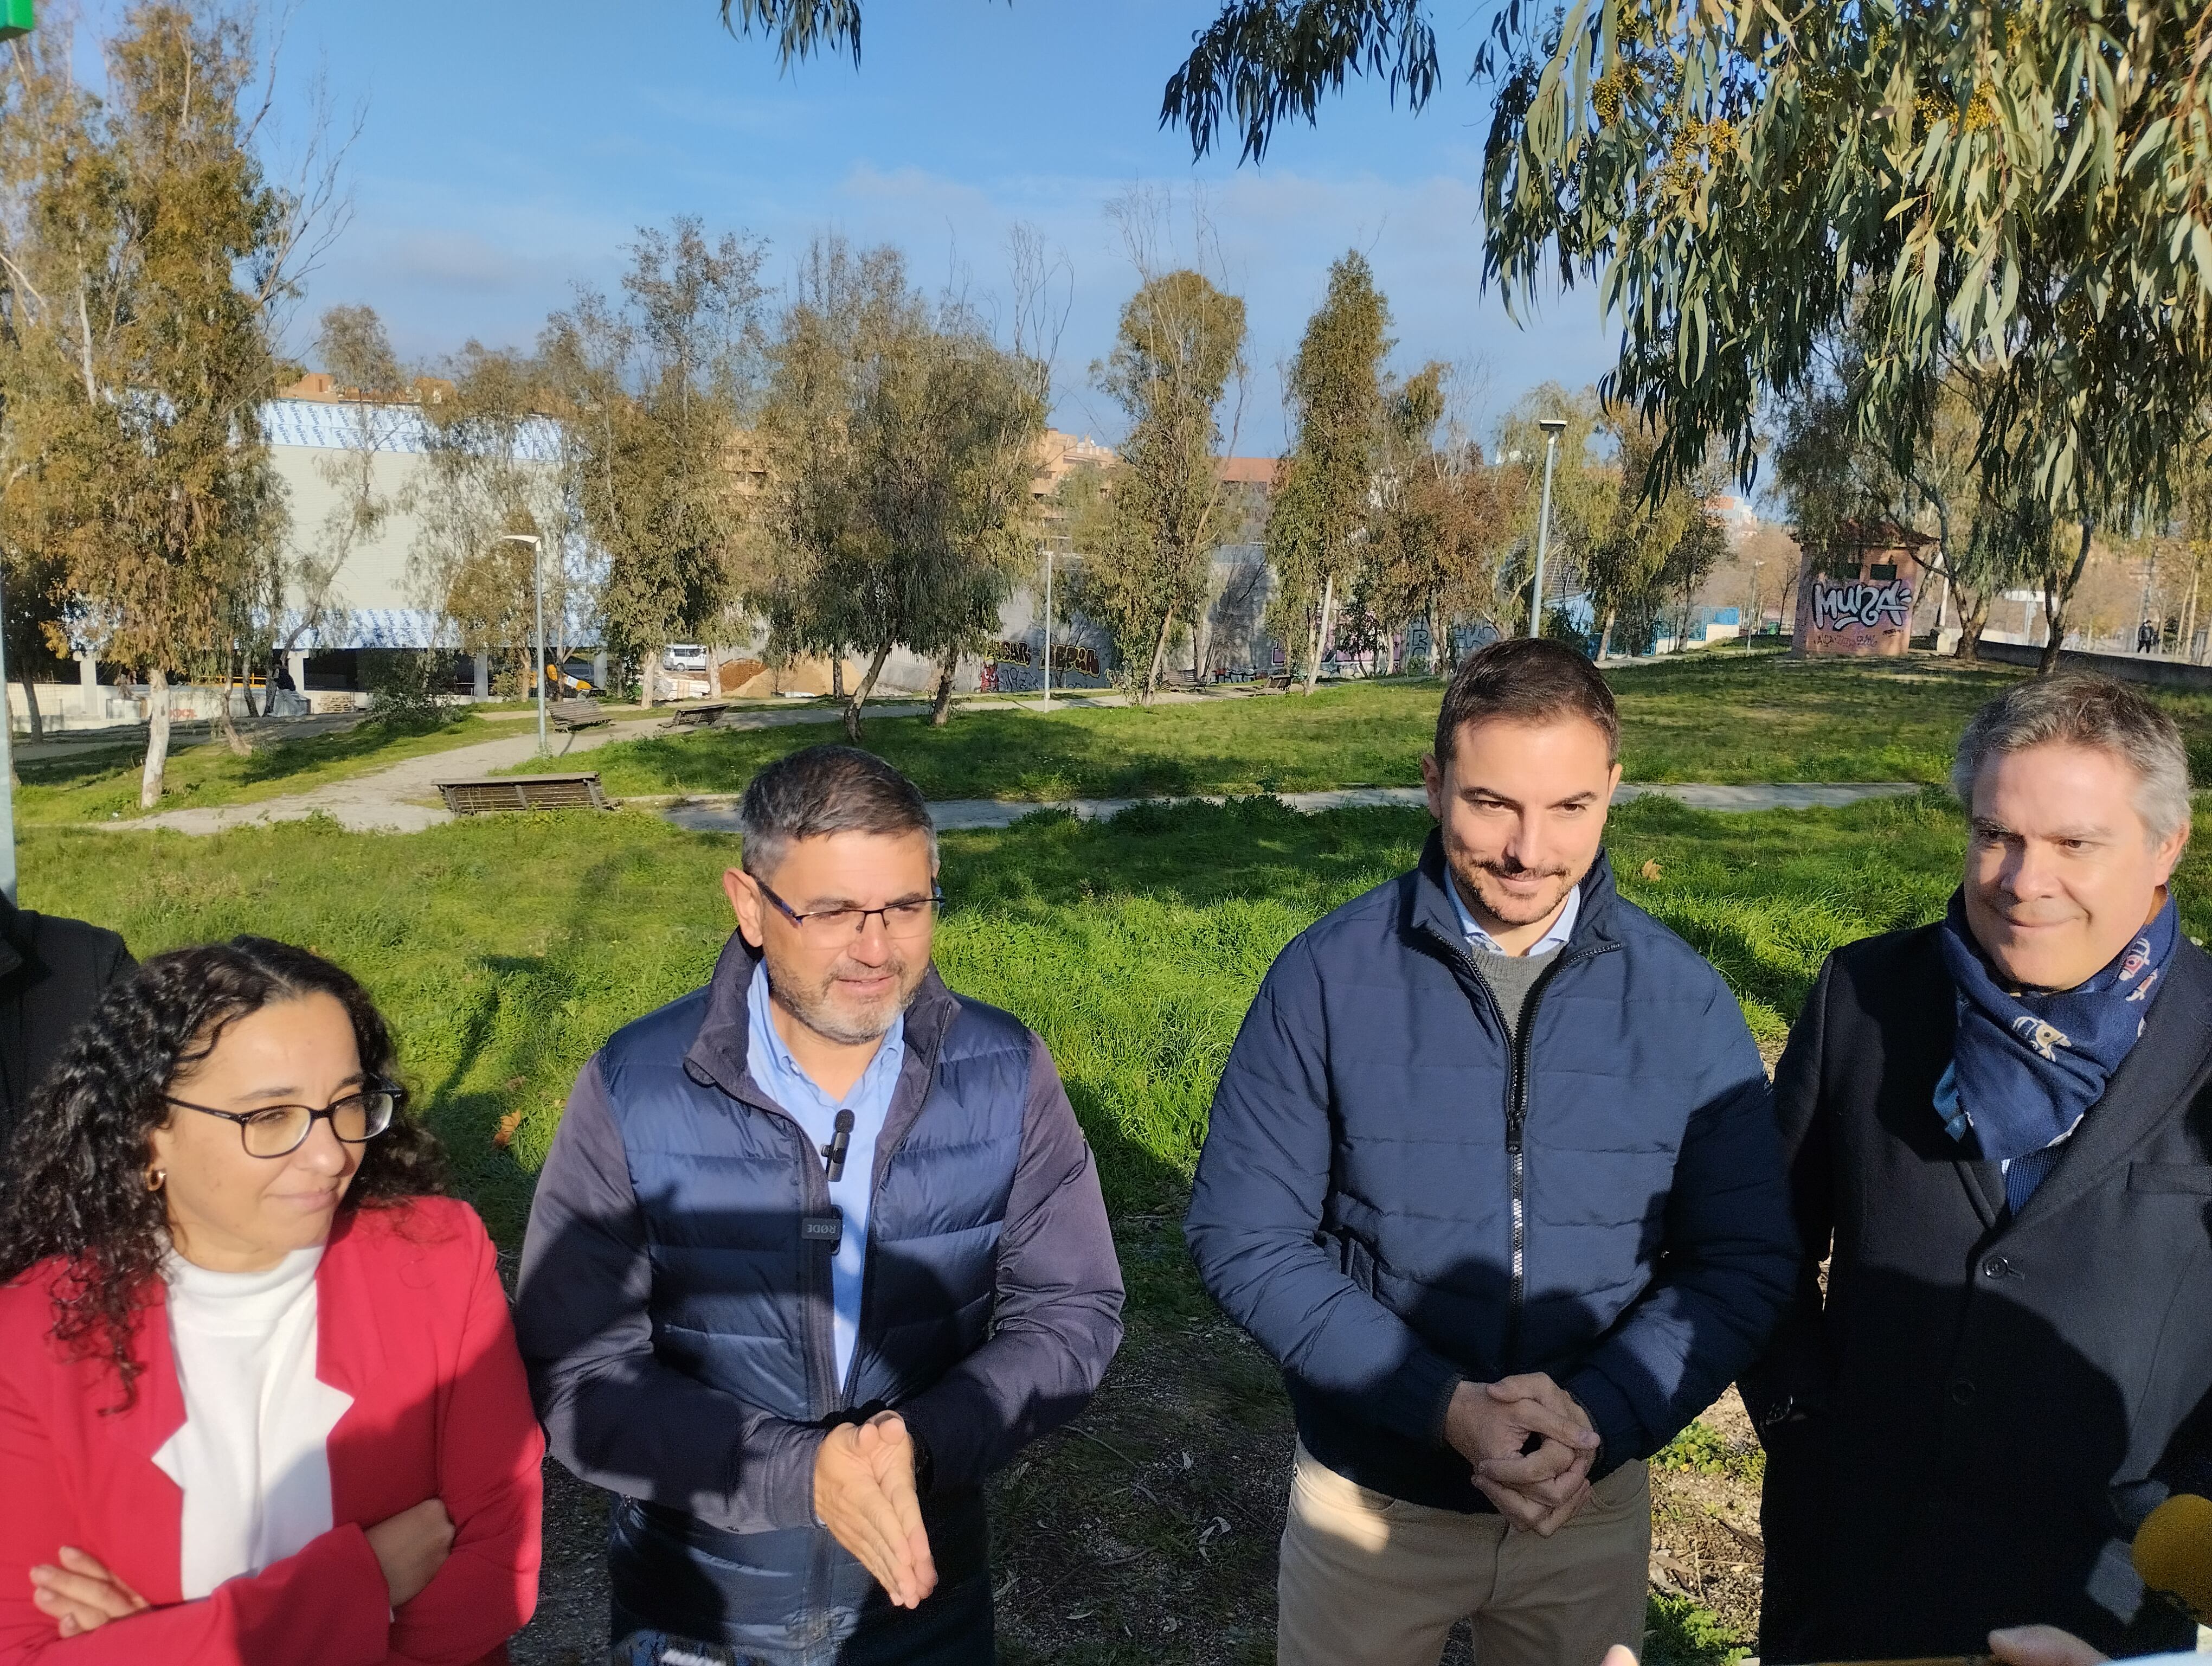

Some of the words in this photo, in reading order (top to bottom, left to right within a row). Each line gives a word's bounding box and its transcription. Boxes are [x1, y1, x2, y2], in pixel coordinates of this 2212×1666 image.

[273, 402, 285, 422] larson
[288, 403, 303, 424] larson
[306, 405, 320, 425] larson
[337, 407, 350, 427] larson
[277, 424, 291, 444] larson
[294, 425, 308, 445] larson
[312, 426, 325, 446] larson
[366, 608, 380, 627] larson
[807, 1224, 837, 1234] RØDE
